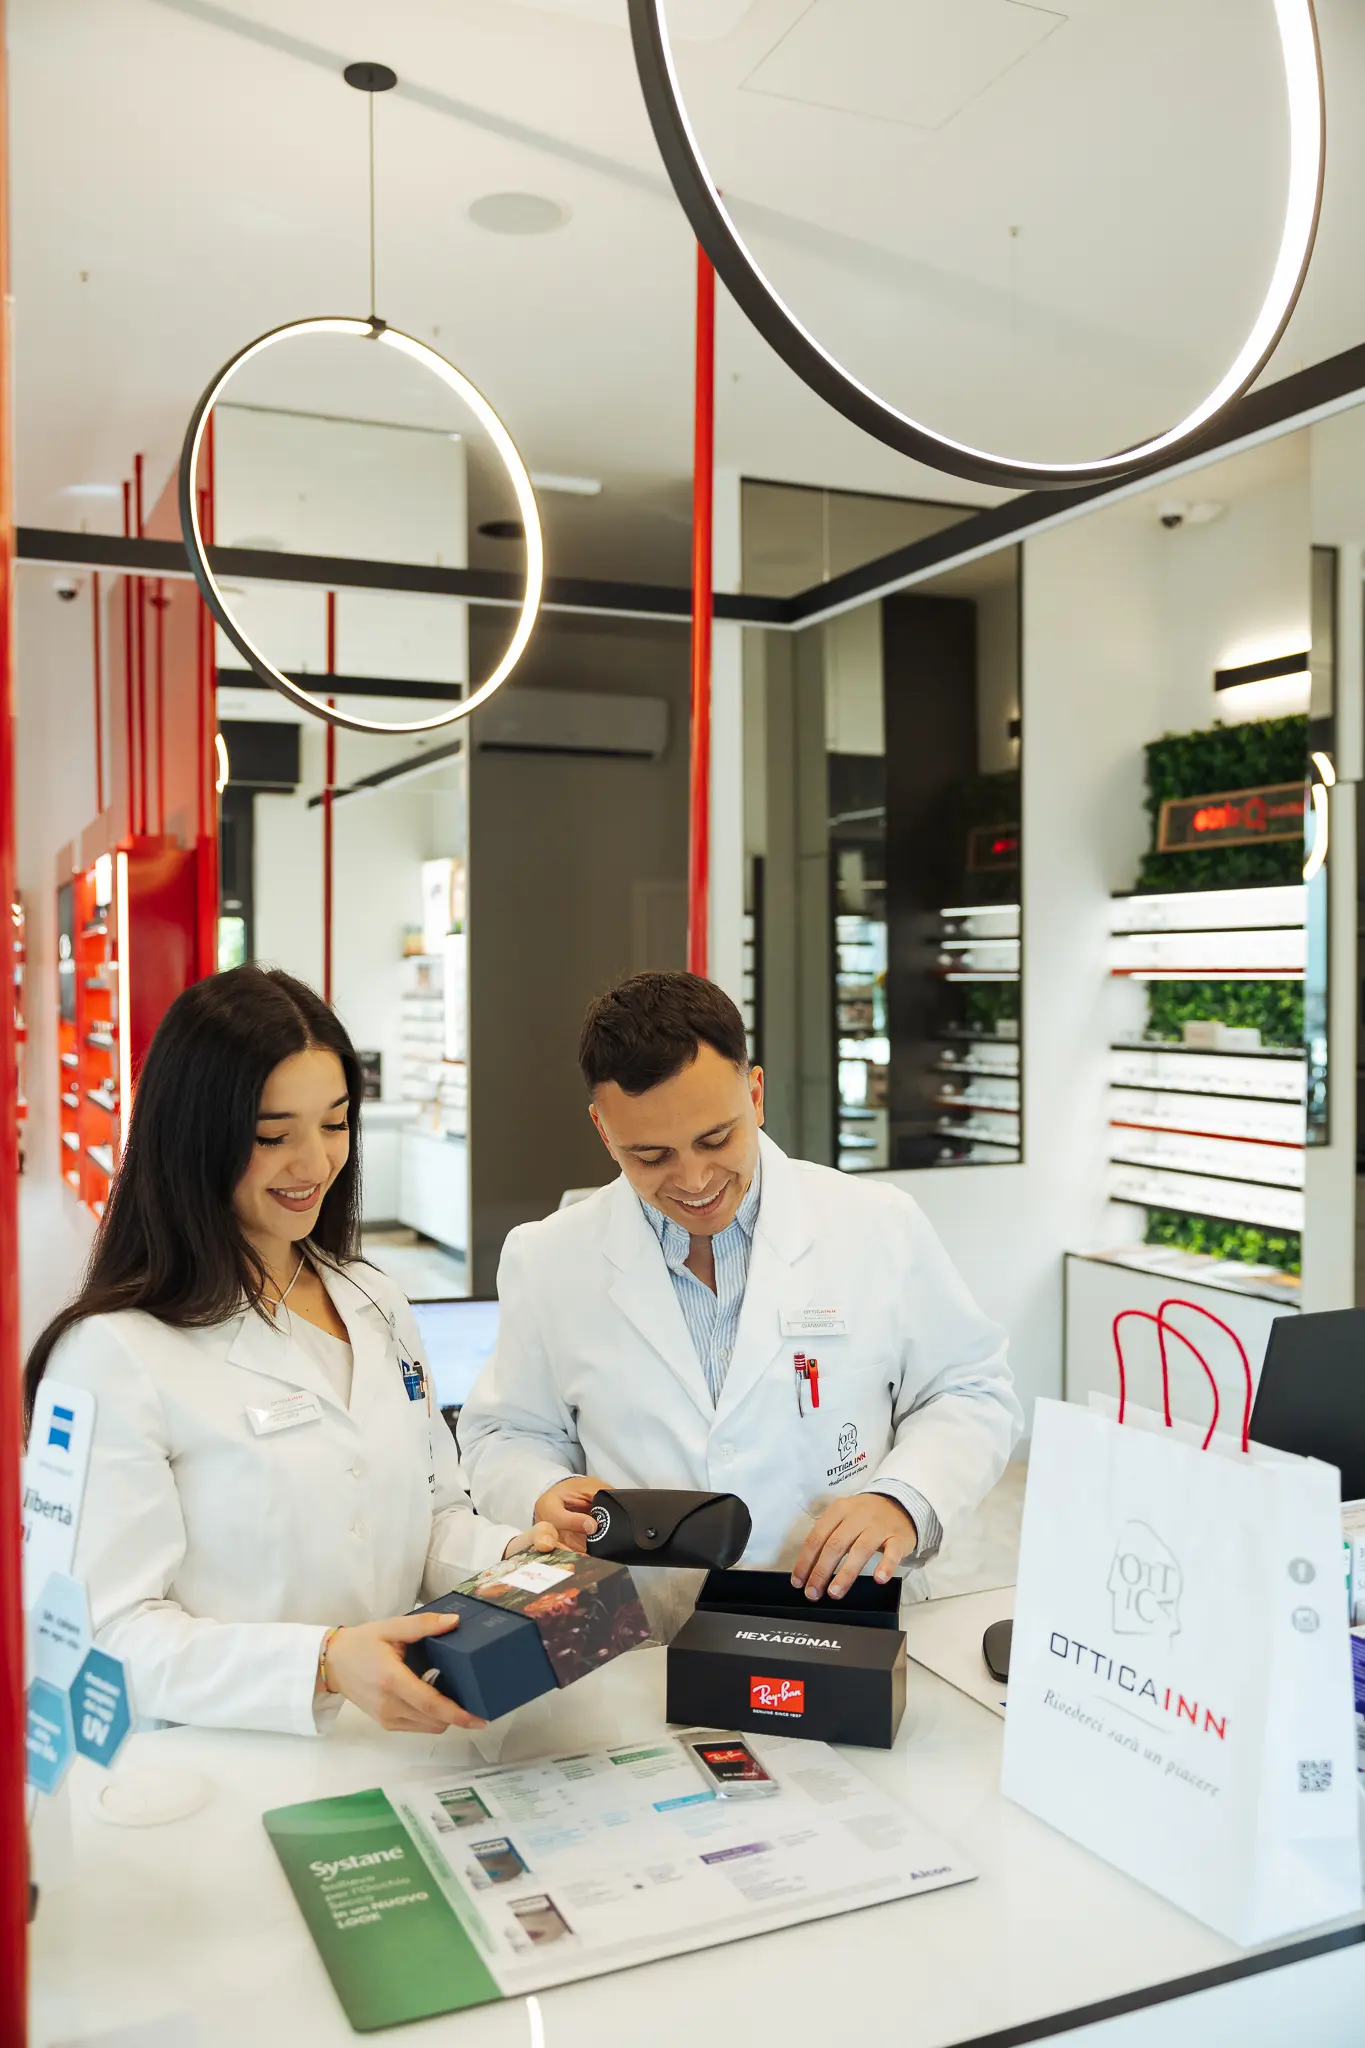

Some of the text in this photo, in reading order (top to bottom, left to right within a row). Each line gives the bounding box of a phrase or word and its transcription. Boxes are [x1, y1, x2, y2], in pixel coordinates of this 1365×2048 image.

[735, 1631, 842, 1649] HEXAGONAL
[1043, 1688, 1106, 1734] Rivederci
[1143, 1747, 1163, 1766] un
[1163, 1758, 1221, 1797] piacere
[309, 1845, 405, 1881] Systane
